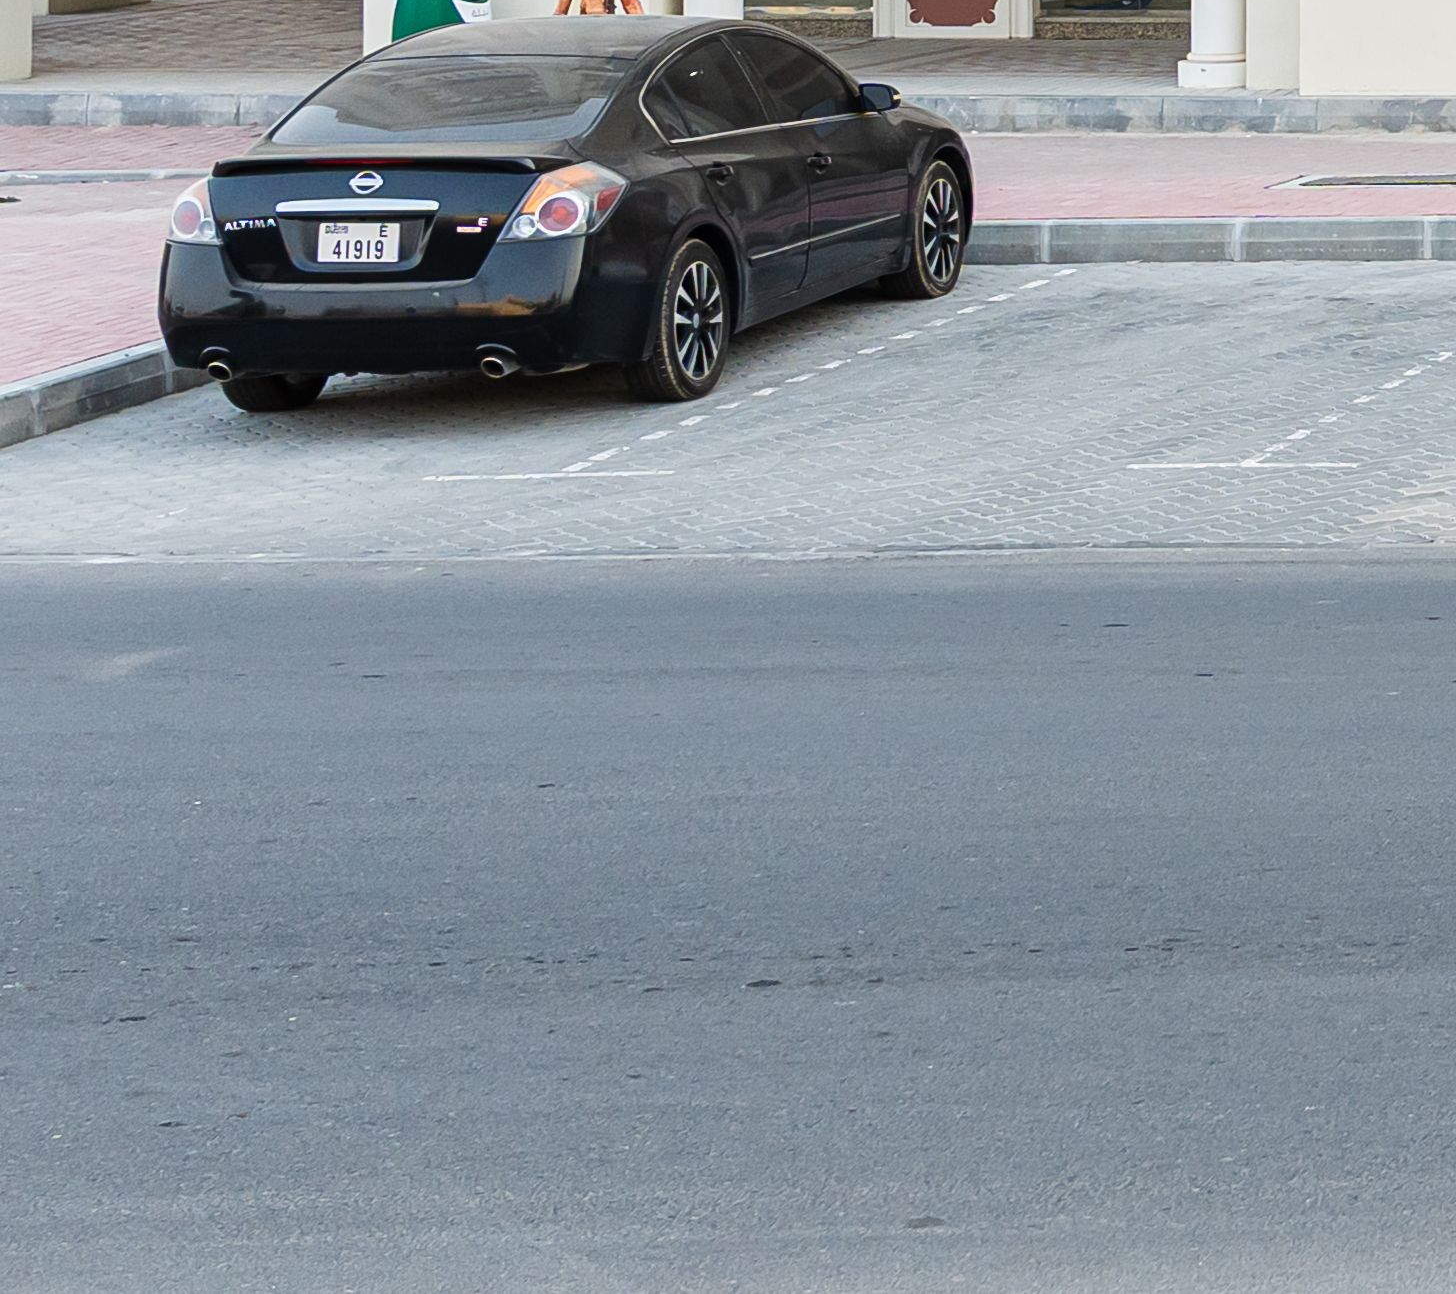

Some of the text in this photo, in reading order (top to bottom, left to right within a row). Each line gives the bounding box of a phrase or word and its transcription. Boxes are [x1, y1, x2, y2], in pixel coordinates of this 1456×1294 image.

[224, 218, 277, 231] ALTIMA
[477, 217, 489, 227] E
[379, 225, 389, 238] E
[332, 239, 384, 260] 41919
